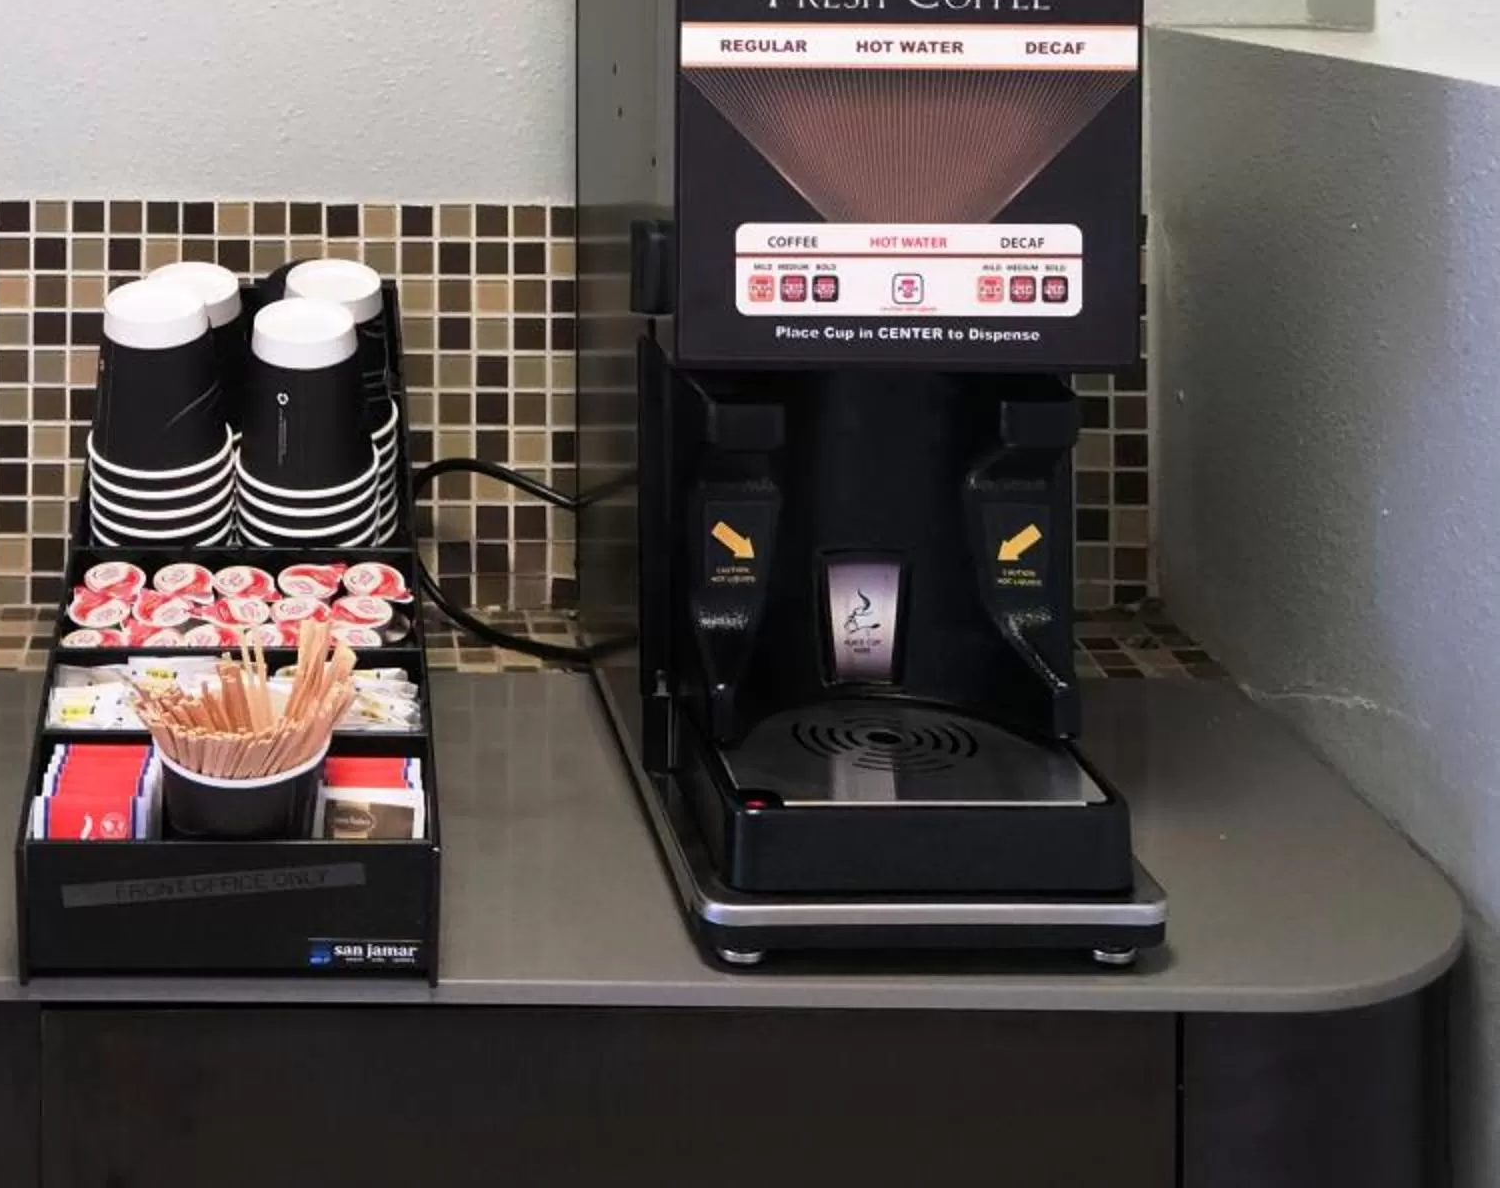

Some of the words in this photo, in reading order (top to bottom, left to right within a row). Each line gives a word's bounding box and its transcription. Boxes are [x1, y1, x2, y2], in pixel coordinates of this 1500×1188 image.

[719, 38, 807, 53] REGULAR
[856, 40, 894, 53] HOT
[900, 40, 964, 55] WATER
[1025, 41, 1085, 55] DECAF
[767, 236, 819, 250] COFFEE
[870, 236, 898, 249] HOT
[901, 236, 948, 250] WATER
[1000, 237, 1045, 250] DECAF
[775, 325, 818, 339] Place
[823, 326, 854, 342] Cup
[859, 326, 873, 339] in
[877, 327, 943, 341] CENTER
[948, 327, 963, 341] to
[968, 327, 1041, 343] Dispense
[333, 945, 363, 957] san
[366, 943, 419, 959] jamar
